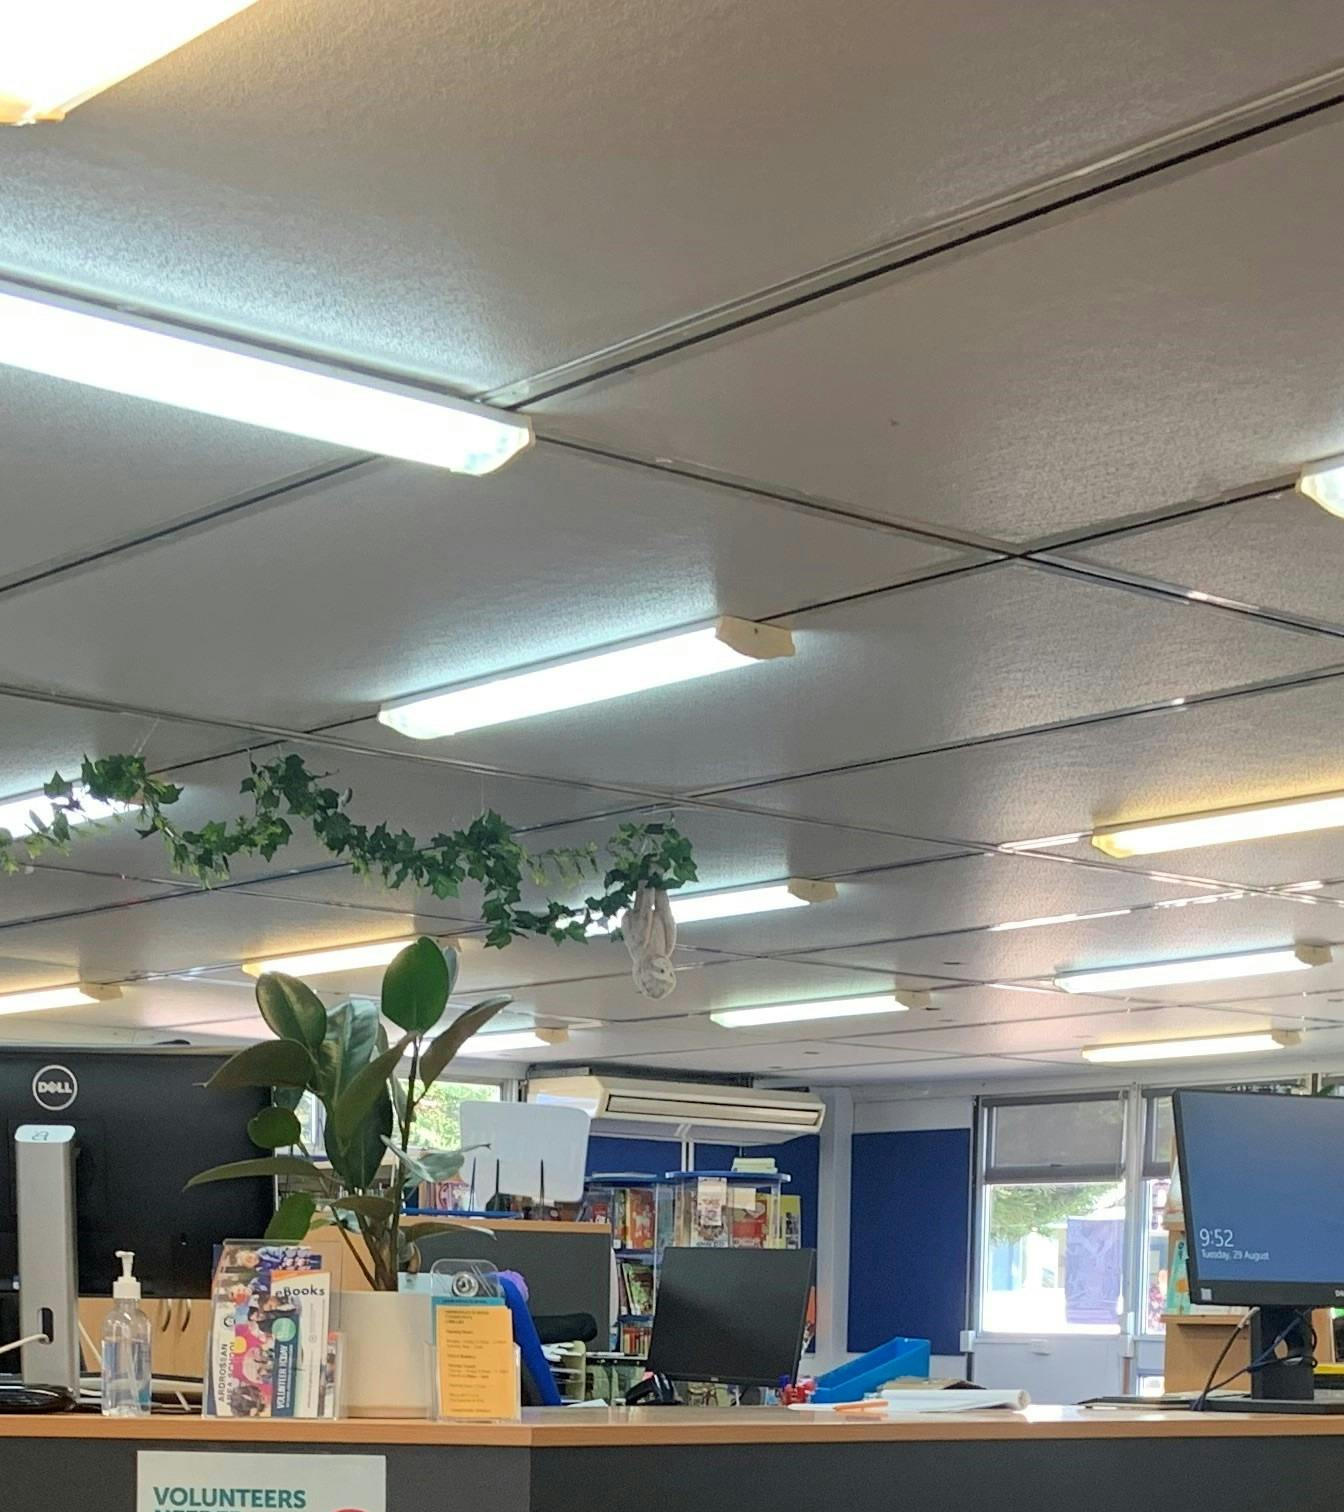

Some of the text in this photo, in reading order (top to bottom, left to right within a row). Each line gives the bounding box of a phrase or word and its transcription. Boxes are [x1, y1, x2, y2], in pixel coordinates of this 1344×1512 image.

[38, 1081, 73, 1094] DELL
[1199, 1228, 1234, 1248] 9:52
[1201, 1249, 1270, 1262] Tuesday, 29 August
[275, 1284, 326, 1297] eBooks
[217, 1343, 228, 1403] ARDROSSAN
[276, 1344, 289, 1409] VOLUNTEER TODAY
[152, 1486, 307, 1510] VOLUNTEERS
